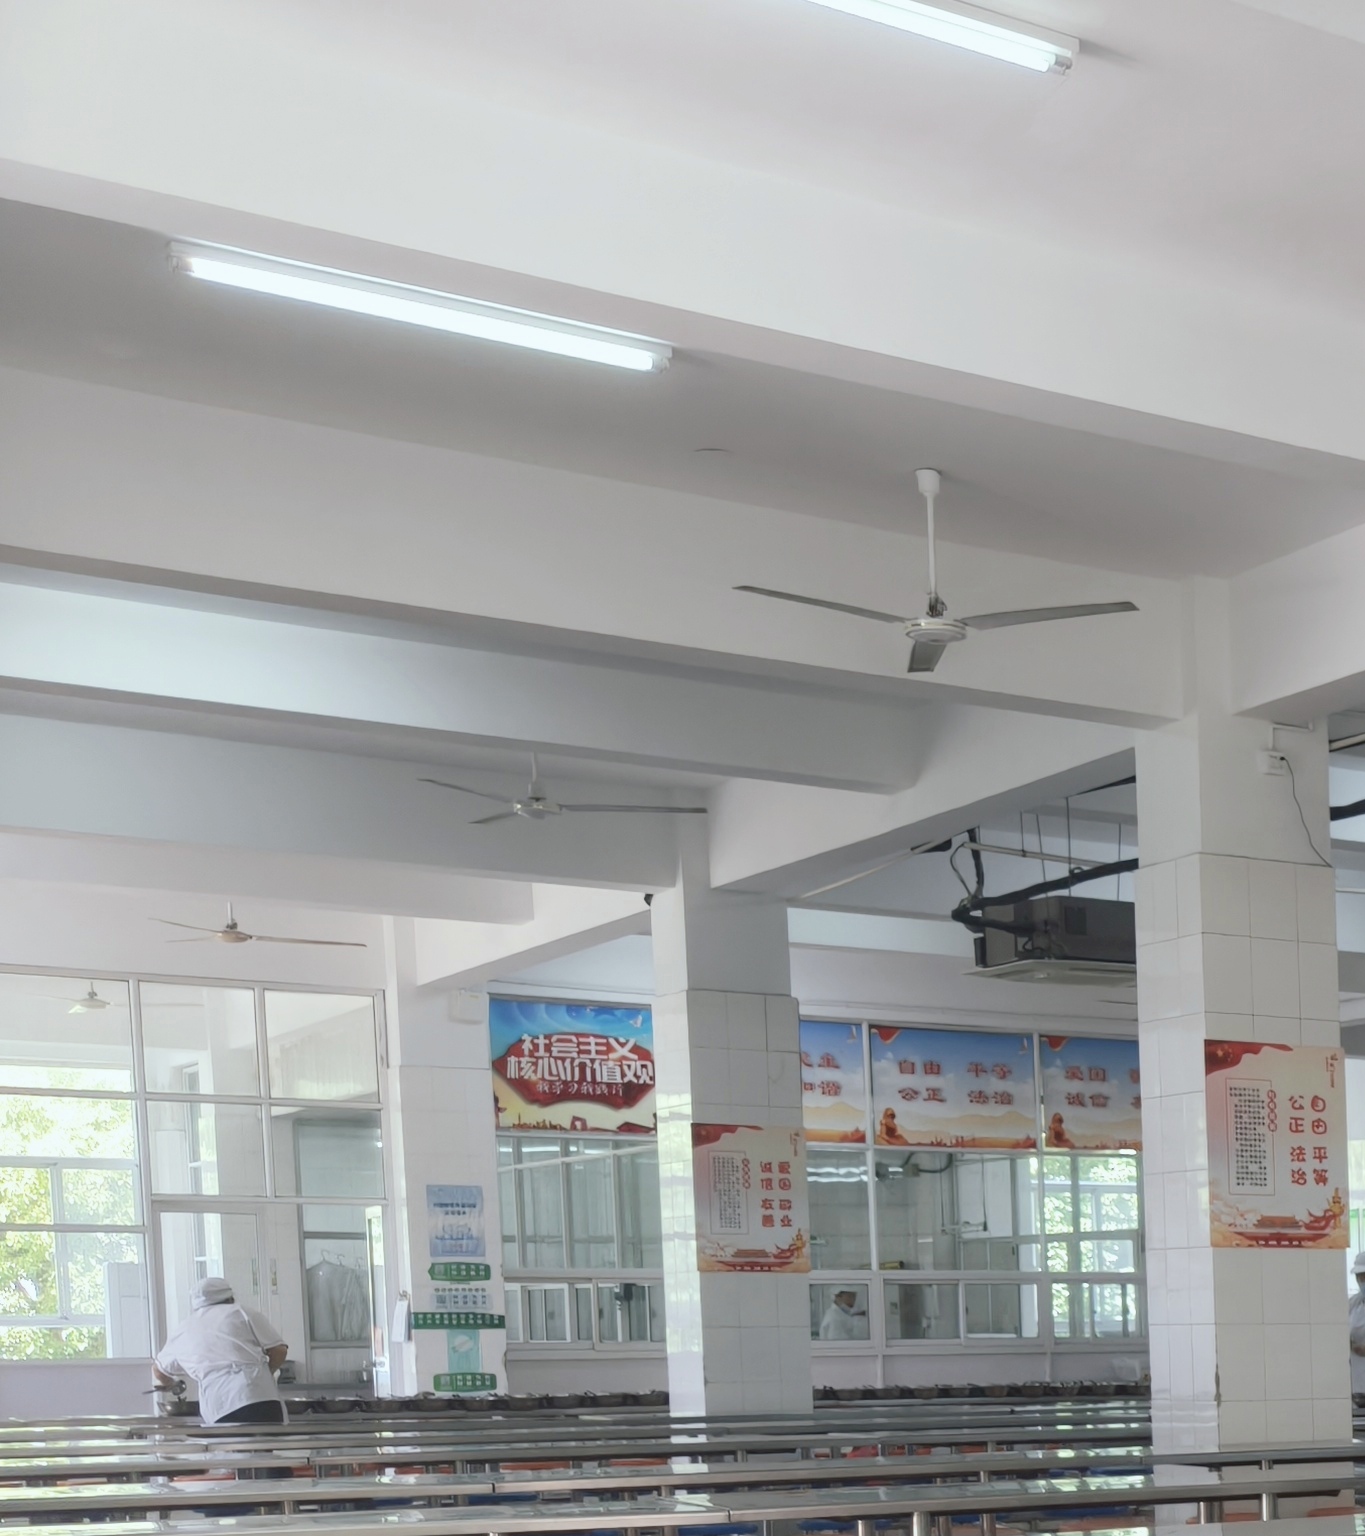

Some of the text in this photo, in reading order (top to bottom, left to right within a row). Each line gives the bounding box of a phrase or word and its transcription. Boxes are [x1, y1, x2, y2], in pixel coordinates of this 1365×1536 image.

[521, 1033, 638, 1060] 社会主义
[507, 1055, 655, 1085] 核心价值观
[898, 1059, 1013, 1080] 自由 平等
[898, 1087, 1014, 1106] 公正 法治
[1310, 1094, 1328, 1135] 自由
[1288, 1094, 1307, 1186] 公正 法治
